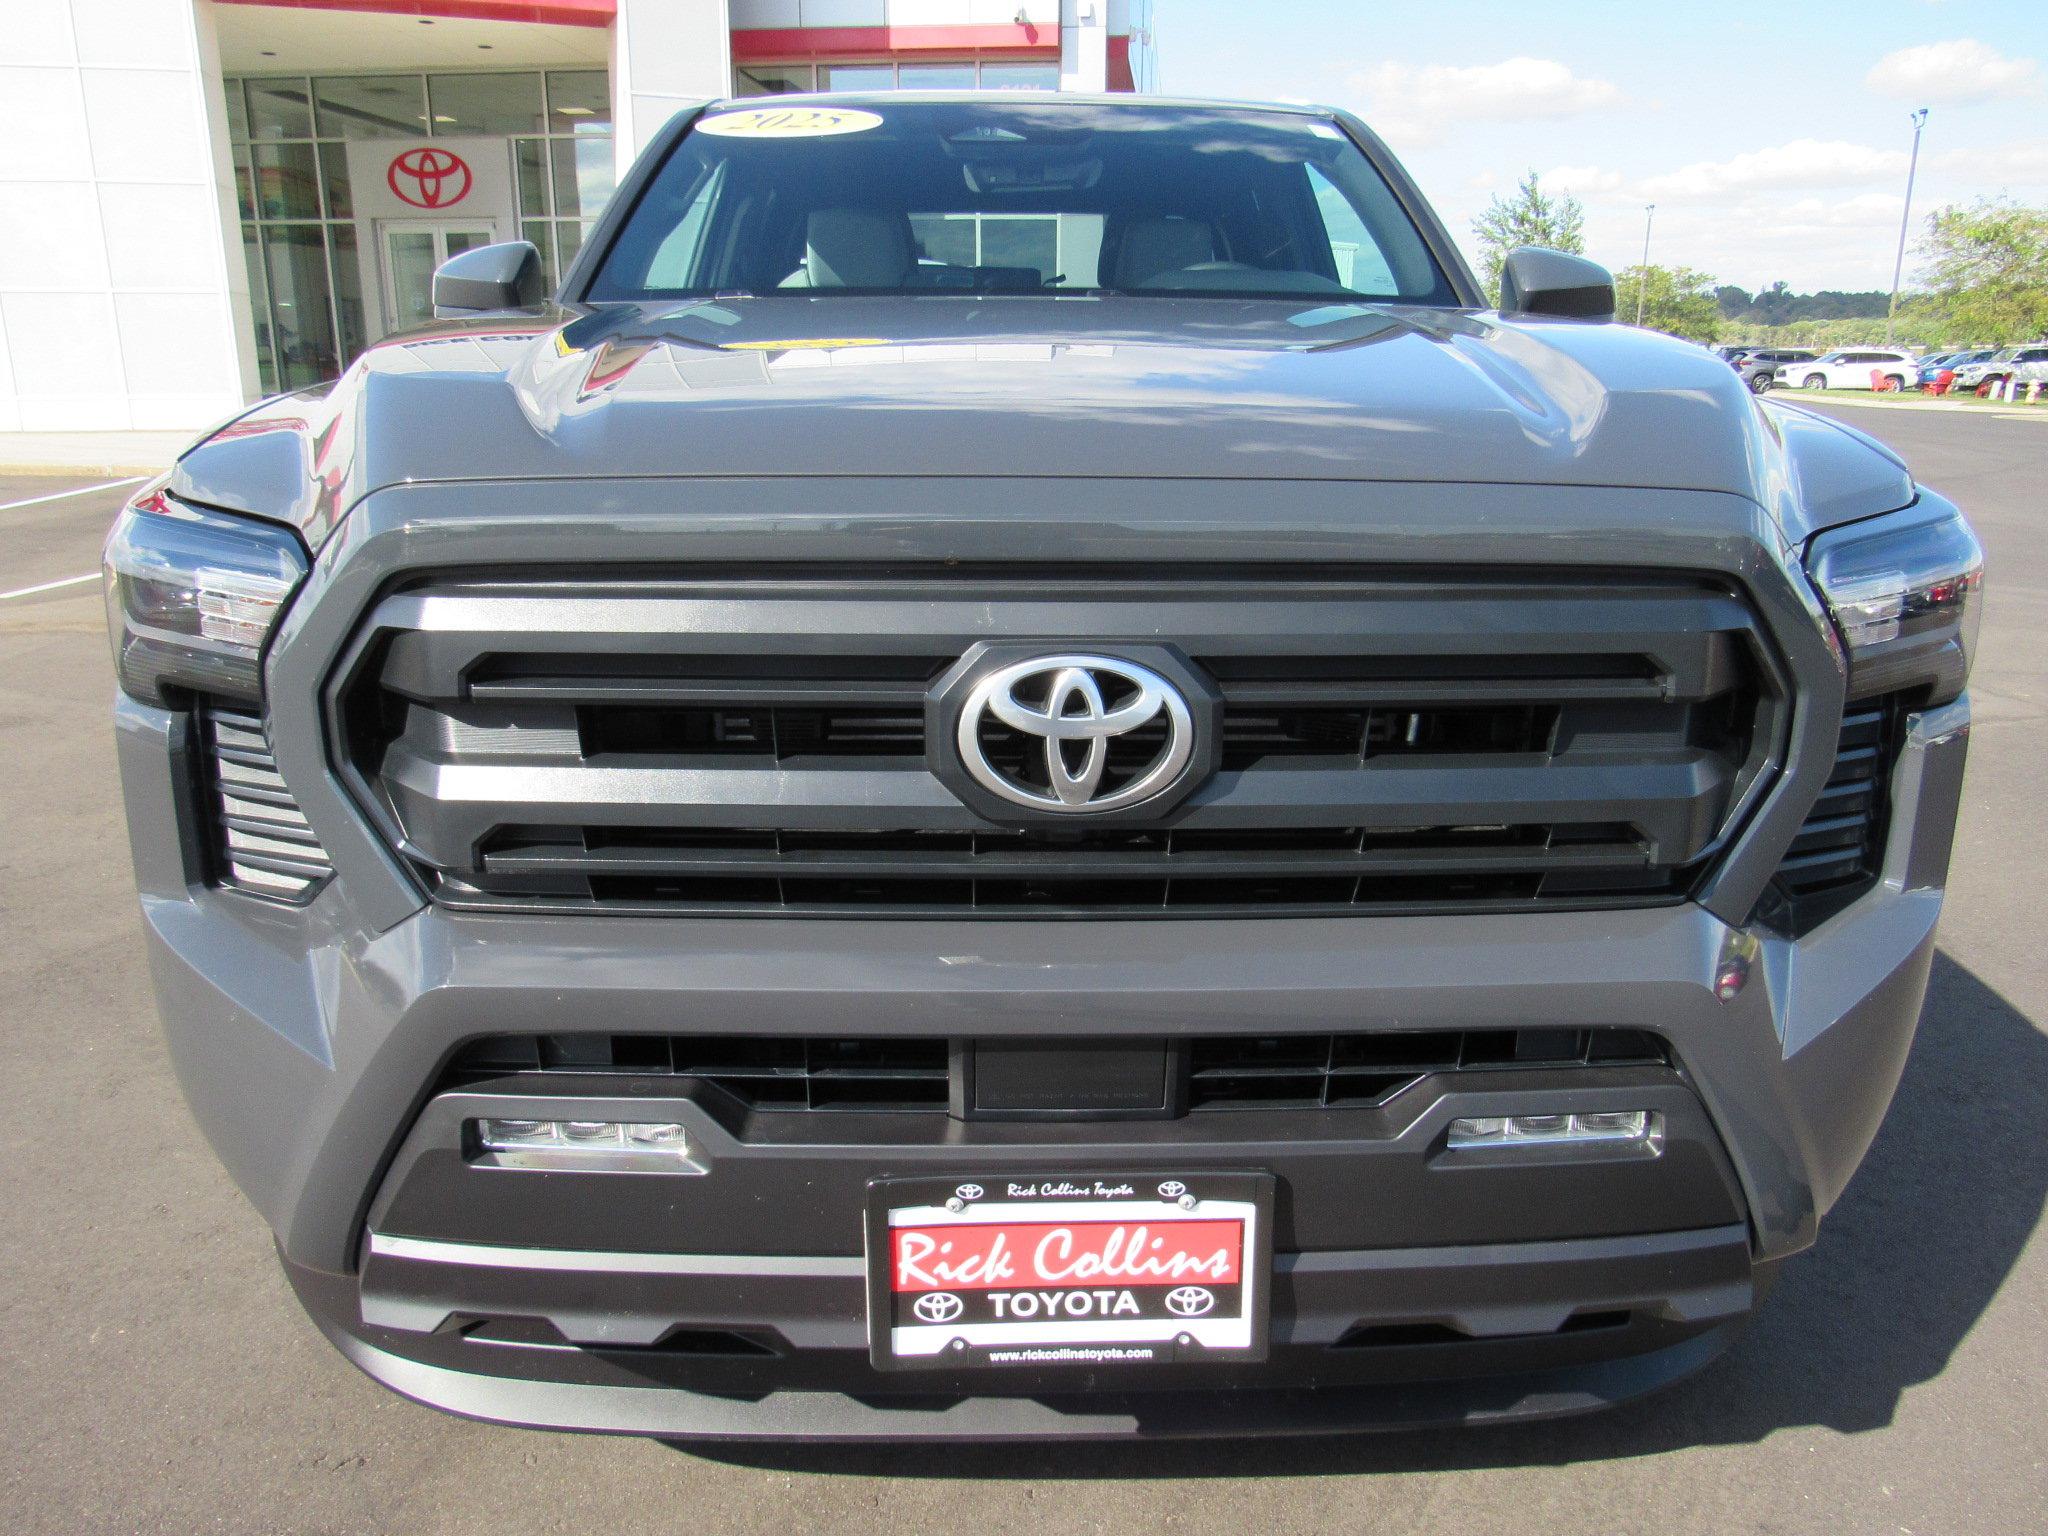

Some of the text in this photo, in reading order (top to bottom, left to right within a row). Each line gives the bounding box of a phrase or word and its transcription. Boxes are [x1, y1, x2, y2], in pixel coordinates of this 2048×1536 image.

[724, 112, 854, 130] 2025
[1007, 1181, 1134, 1199] Rick Collins Toyota
[899, 1226, 1229, 1286] Rick Collins
[988, 1291, 1140, 1317] TOYOTA
[989, 1348, 1153, 1362] www.rickcollinstoyota.com
